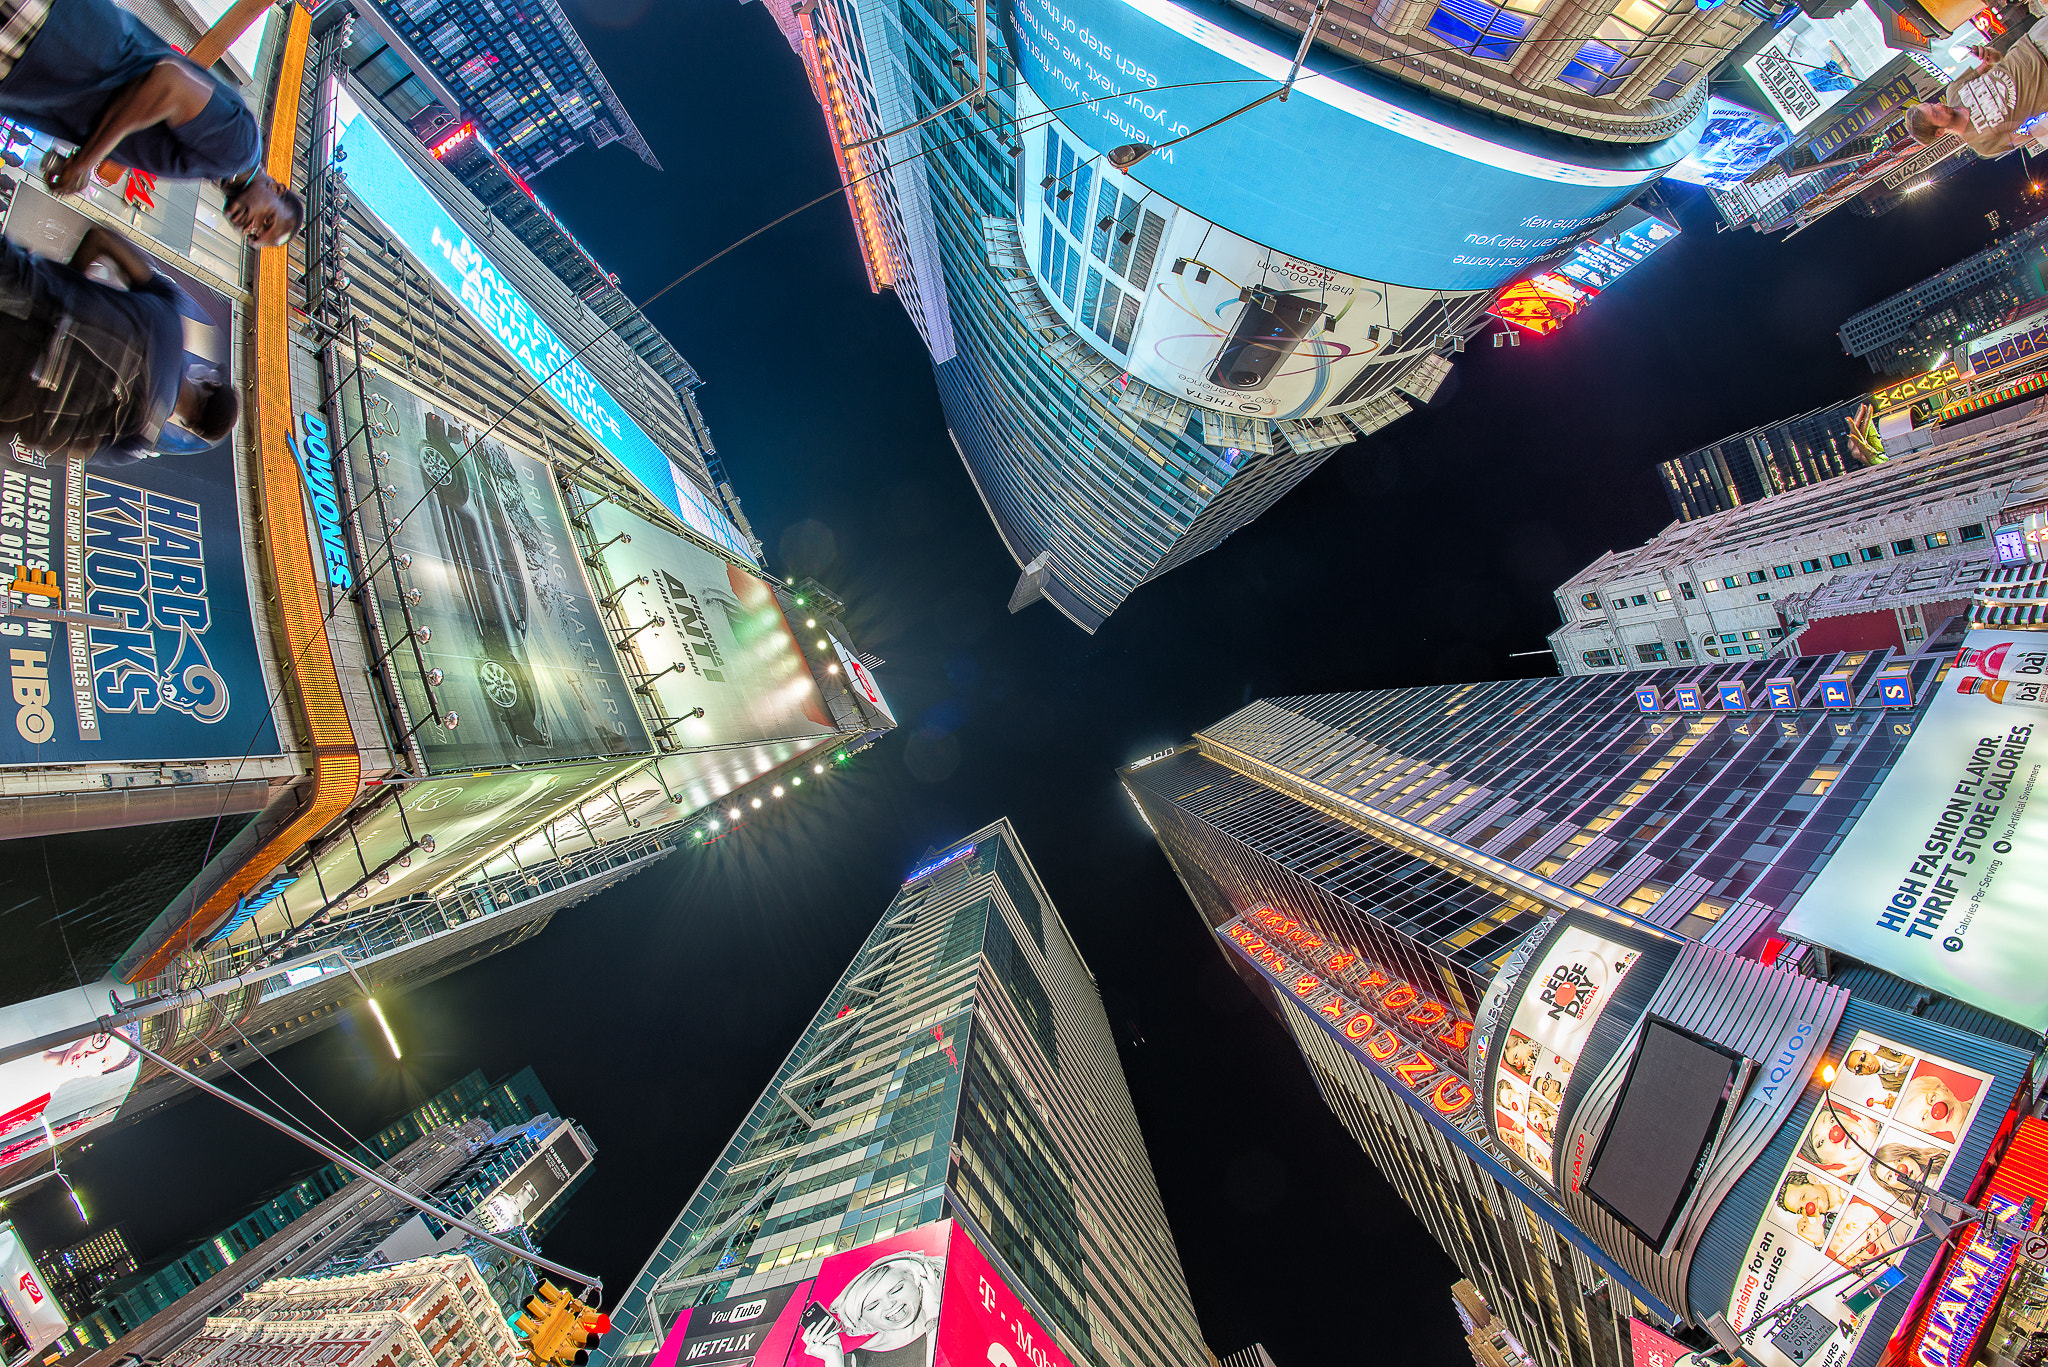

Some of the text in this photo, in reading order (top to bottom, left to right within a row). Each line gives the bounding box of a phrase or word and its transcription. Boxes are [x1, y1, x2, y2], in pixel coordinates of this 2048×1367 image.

[1082, 27, 1116, 59] step
[1090, 61, 1125, 98] next,
[1115, 54, 1158, 88] each
[1761, 57, 1809, 117] WORK
[1772, 50, 1817, 107] FOOTWEAR
[1905, 51, 1953, 86] SKECHERS
[1131, 96, 1172, 128] your
[1877, 79, 1912, 112] NEW
[1814, 106, 1875, 157] VICTORY
[1885, 167, 1903, 188] NEW
[1902, 158, 1919, 182] 42
[1925, 134, 1960, 164] STUDIOS
[1464, 231, 1504, 246] you
[1501, 233, 1536, 248] help
[1520, 214, 1552, 230] way.
[1284, 260, 1335, 281] RICOH
[1454, 254, 1502, 268] home
[431, 227, 543, 352] HEALTHY
[546, 352, 623, 441] CHOICE
[460, 237, 528, 317] MAKE
[532, 317, 597, 394] EVERY
[460, 281, 604, 439] REWARDING
[1186, 388, 1234, 408] THETA
[1874, 364, 1959, 410] MADAME
[0, 470, 27, 529] KICKS
[67, 457, 83, 507] TRAINING
[26, 477, 52, 572] TUESDAYS
[66, 508, 81, 542] CAMP
[0, 534, 24, 568] OFF
[66, 545, 81, 573] WITH
[144, 490, 212, 634] HARD
[67, 577, 82, 599] THE
[85, 473, 162, 713] KNOCKS
[520, 464, 567, 581] DRIVING
[562, 592, 628, 737] MATTERS
[660, 568, 726, 683] ANTI
[688, 593, 725, 667] RIHANNA
[70, 629, 91, 687] ANGELES
[10, 649, 55, 744] HBO
[76, 691, 96, 730] RAMS
[1641, 685, 1906, 711] CHAMPS
[2001, 763, 2042, 841] No Artificial Sweeteners
[1876, 735, 2003, 932] HIGH FASHION FLAVOR.
[1905, 723, 2034, 940] THRIFT STORE CALORIES.
[1944, 858, 2003, 951] 5 Calories Per Serving
[1484, 914, 1561, 1033] NBCUNIVERSAL
[1540, 964, 1569, 1006] RED
[1614, 961, 1627, 974] 4
[1564, 975, 1595, 1018] DAY
[1576, 985, 1600, 1021] SPECIAL
[1231, 924, 1473, 1112] ERNST & YOUNG
[1762, 1023, 1812, 1100] AQUOS
[1571, 1133, 1586, 1195] SHARP
[1694, 1141, 1713, 1179] SHARP
[2022, 1202, 2031, 1213] 42
[1749, 1251, 1765, 1274] for
[1760, 1231, 1775, 1252] an
[1763, 1246, 1787, 1291] cause
[709, 1302, 763, 1325] YouTube
[1863, 1289, 1875, 1300] 7
[685, 1332, 756, 1361] NETFLIX
[1780, 1313, 1809, 1341] BUSES
[1793, 1324, 1816, 1347] ONLY
[1839, 1319, 1855, 1339] 4
[1849, 1314, 1867, 1345] NEW YORK
